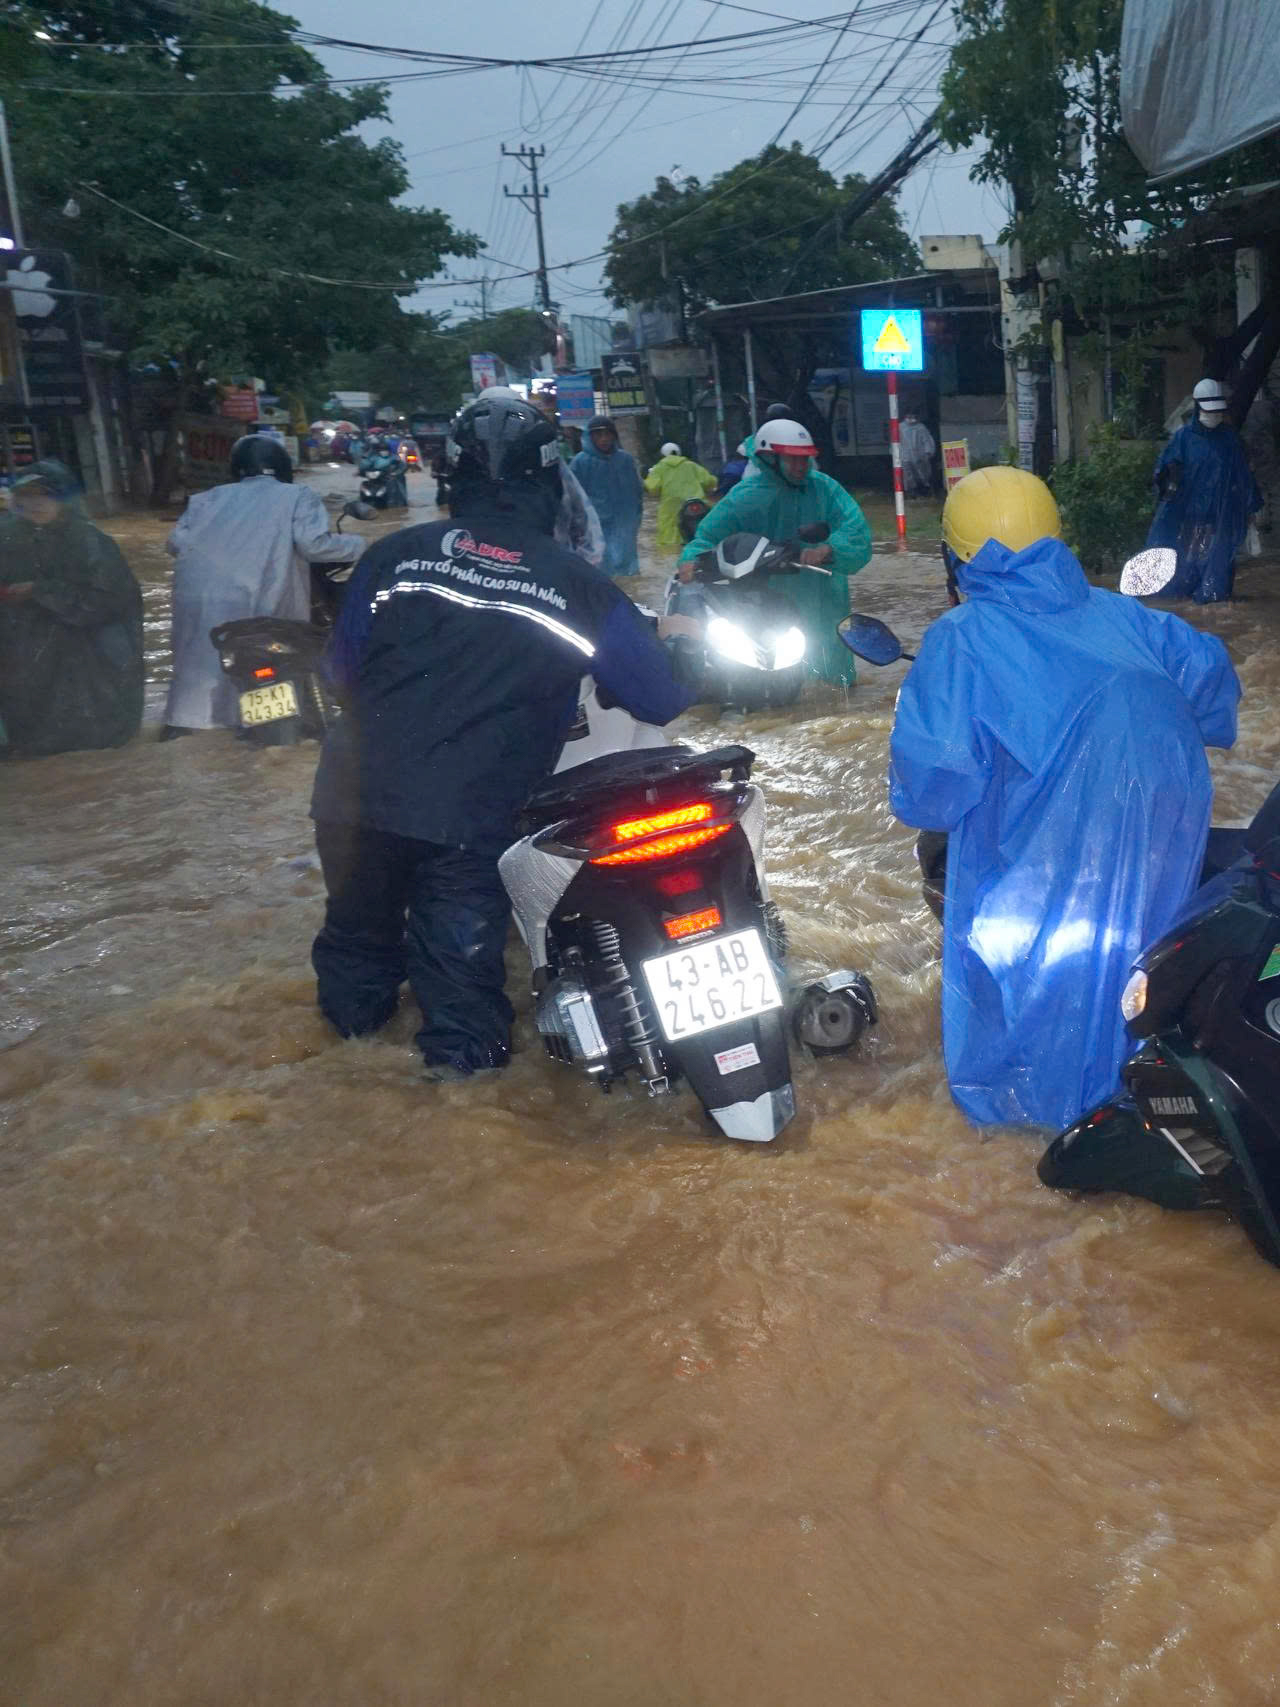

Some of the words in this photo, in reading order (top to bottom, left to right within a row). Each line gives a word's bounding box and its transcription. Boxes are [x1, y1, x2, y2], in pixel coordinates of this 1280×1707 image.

[420, 560, 436, 571] TY
[482, 577, 506, 591] CAO
[505, 579, 521, 592] SU
[521, 582, 537, 597] ĐÀ
[247, 685, 286, 708] 75-K1
[665, 938, 750, 991] 43-AB
[663, 972, 775, 1036] 246.22
[1148, 1096, 1199, 1115] YAMAHA
